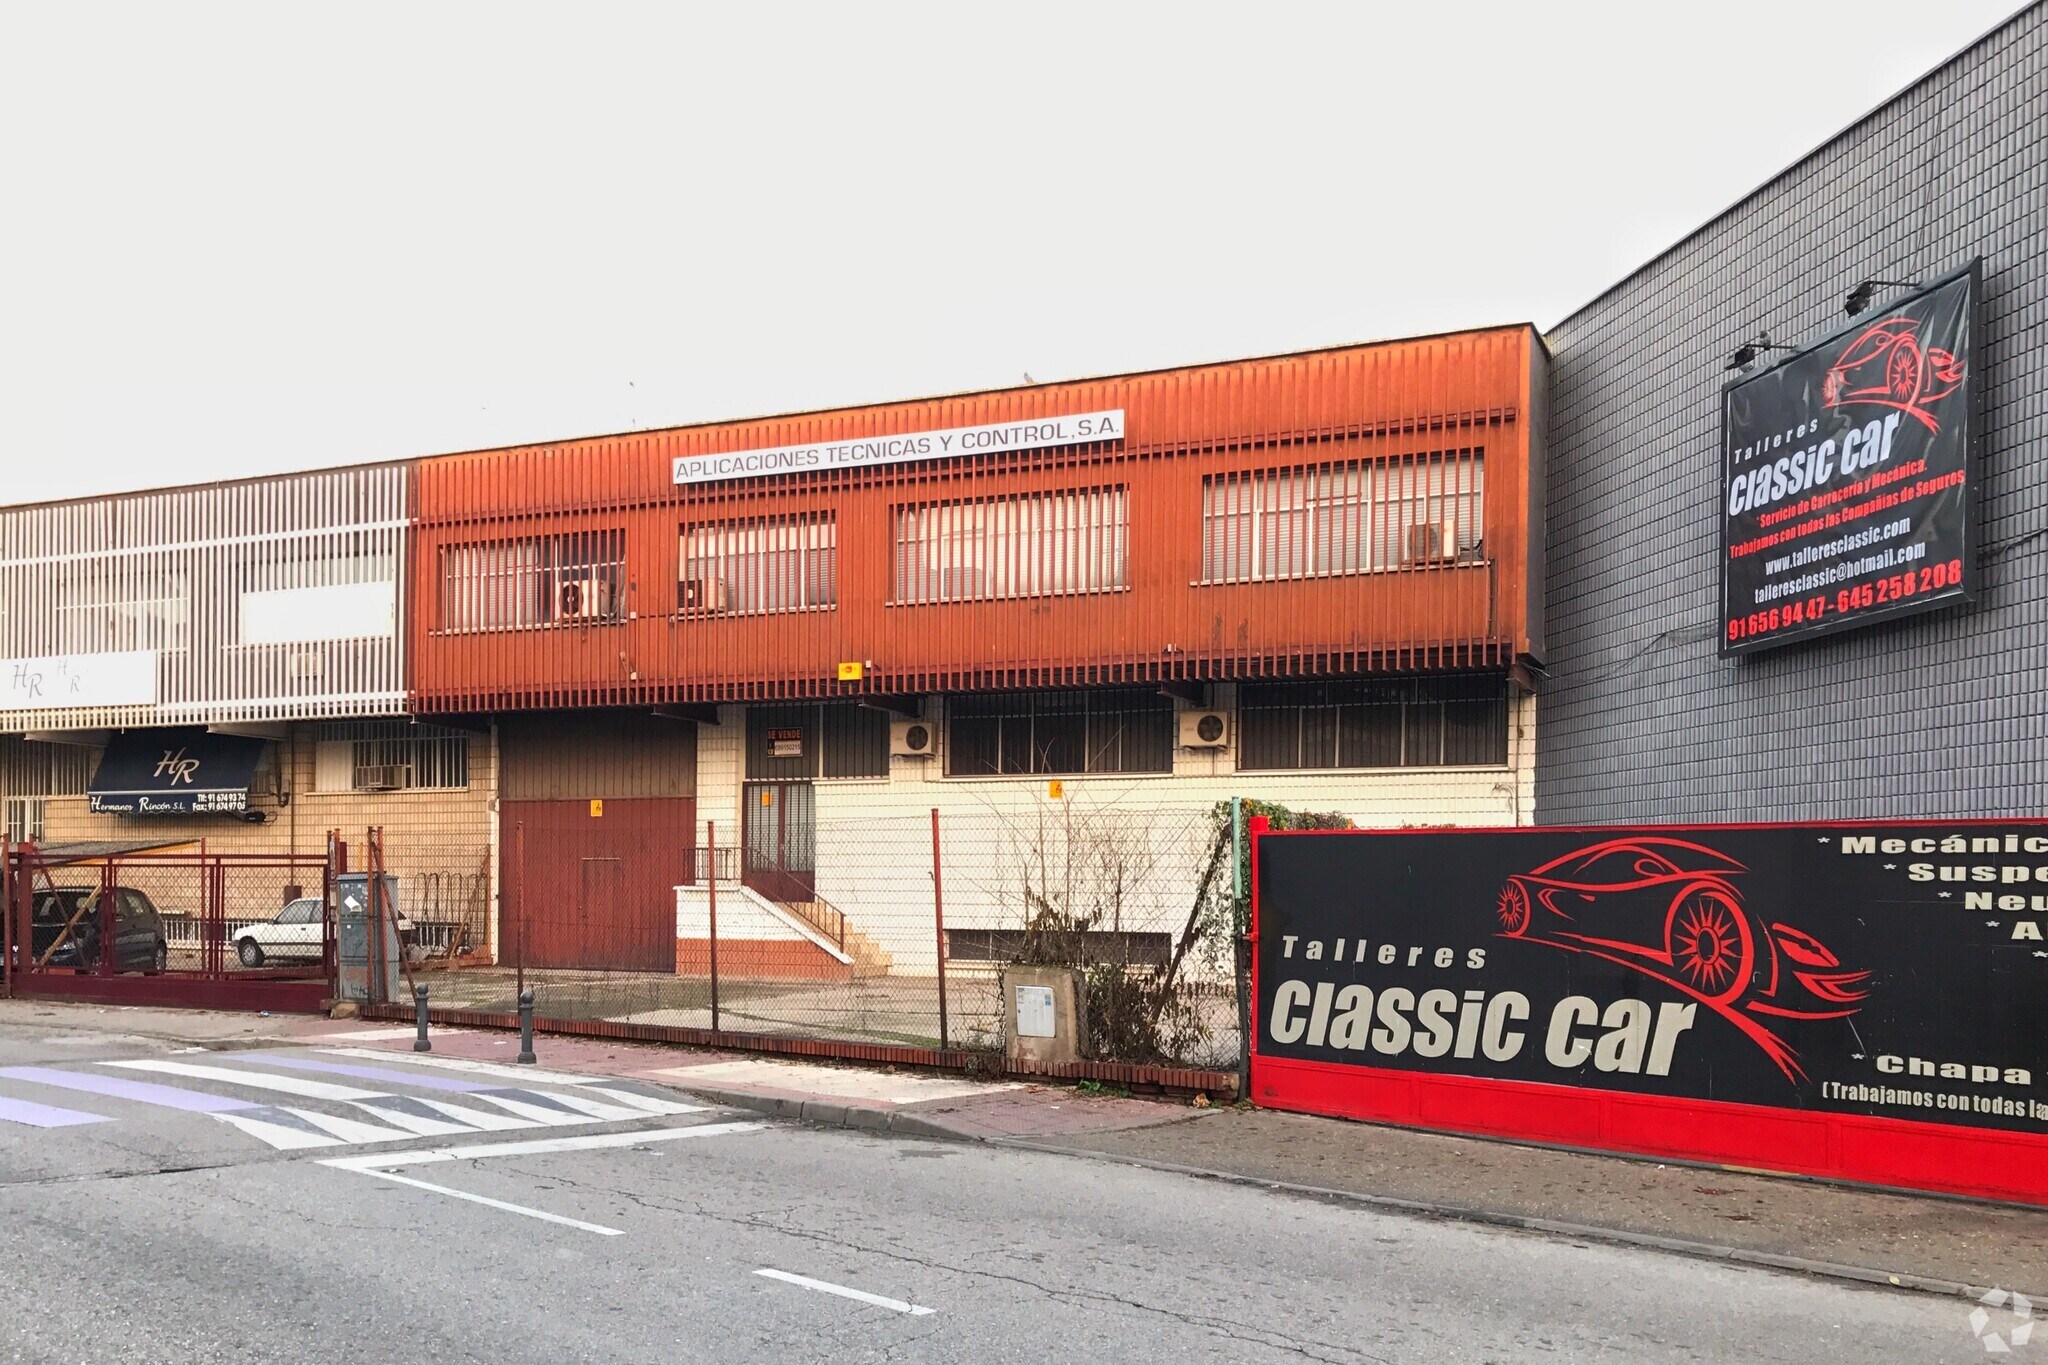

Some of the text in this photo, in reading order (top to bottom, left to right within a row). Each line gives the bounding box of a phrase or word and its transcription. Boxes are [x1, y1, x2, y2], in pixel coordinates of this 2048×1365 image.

[675, 449, 819, 478] APLICACIONES
[826, 437, 931, 463] TECNICAS
[939, 435, 955, 451] Y
[1734, 418, 1818, 464] Talleres
[1730, 532, 1779, 559] Trabajamos
[1780, 527, 1796, 542] con
[1797, 516, 1824, 537] todas
[1825, 511, 1840, 529] las
[1900, 486, 1914, 503] de
[1916, 469, 1965, 497] Seguros
[1760, 504, 1796, 528] Servicio
[1797, 500, 1810, 516] de
[1864, 477, 1872, 493] y
[1765, 517, 1911, 576] www.talleresclassic.com
[1755, 541, 1926, 604] talleresclassic@hotmail.com
[1728, 617, 1746, 640] 91
[1748, 608, 1779, 635] 656
[1782, 602, 1803, 627] 94
[1806, 595, 1825, 620] 47
[1837, 583, 1873, 613] 645
[1876, 571, 1916, 603] 258
[1920, 559, 1962, 592] 208
[778, 729, 801, 739] VENDE
[153, 747, 200, 786] HR
[90, 795, 134, 811] Hermanos
[138, 796, 171, 812] Rincón
[192, 802, 207, 811] Fax:
[1282, 935, 1487, 969] Talleres
[1936, 1093, 1970, 1111] con
[1973, 1095, 2025, 1117] todas
